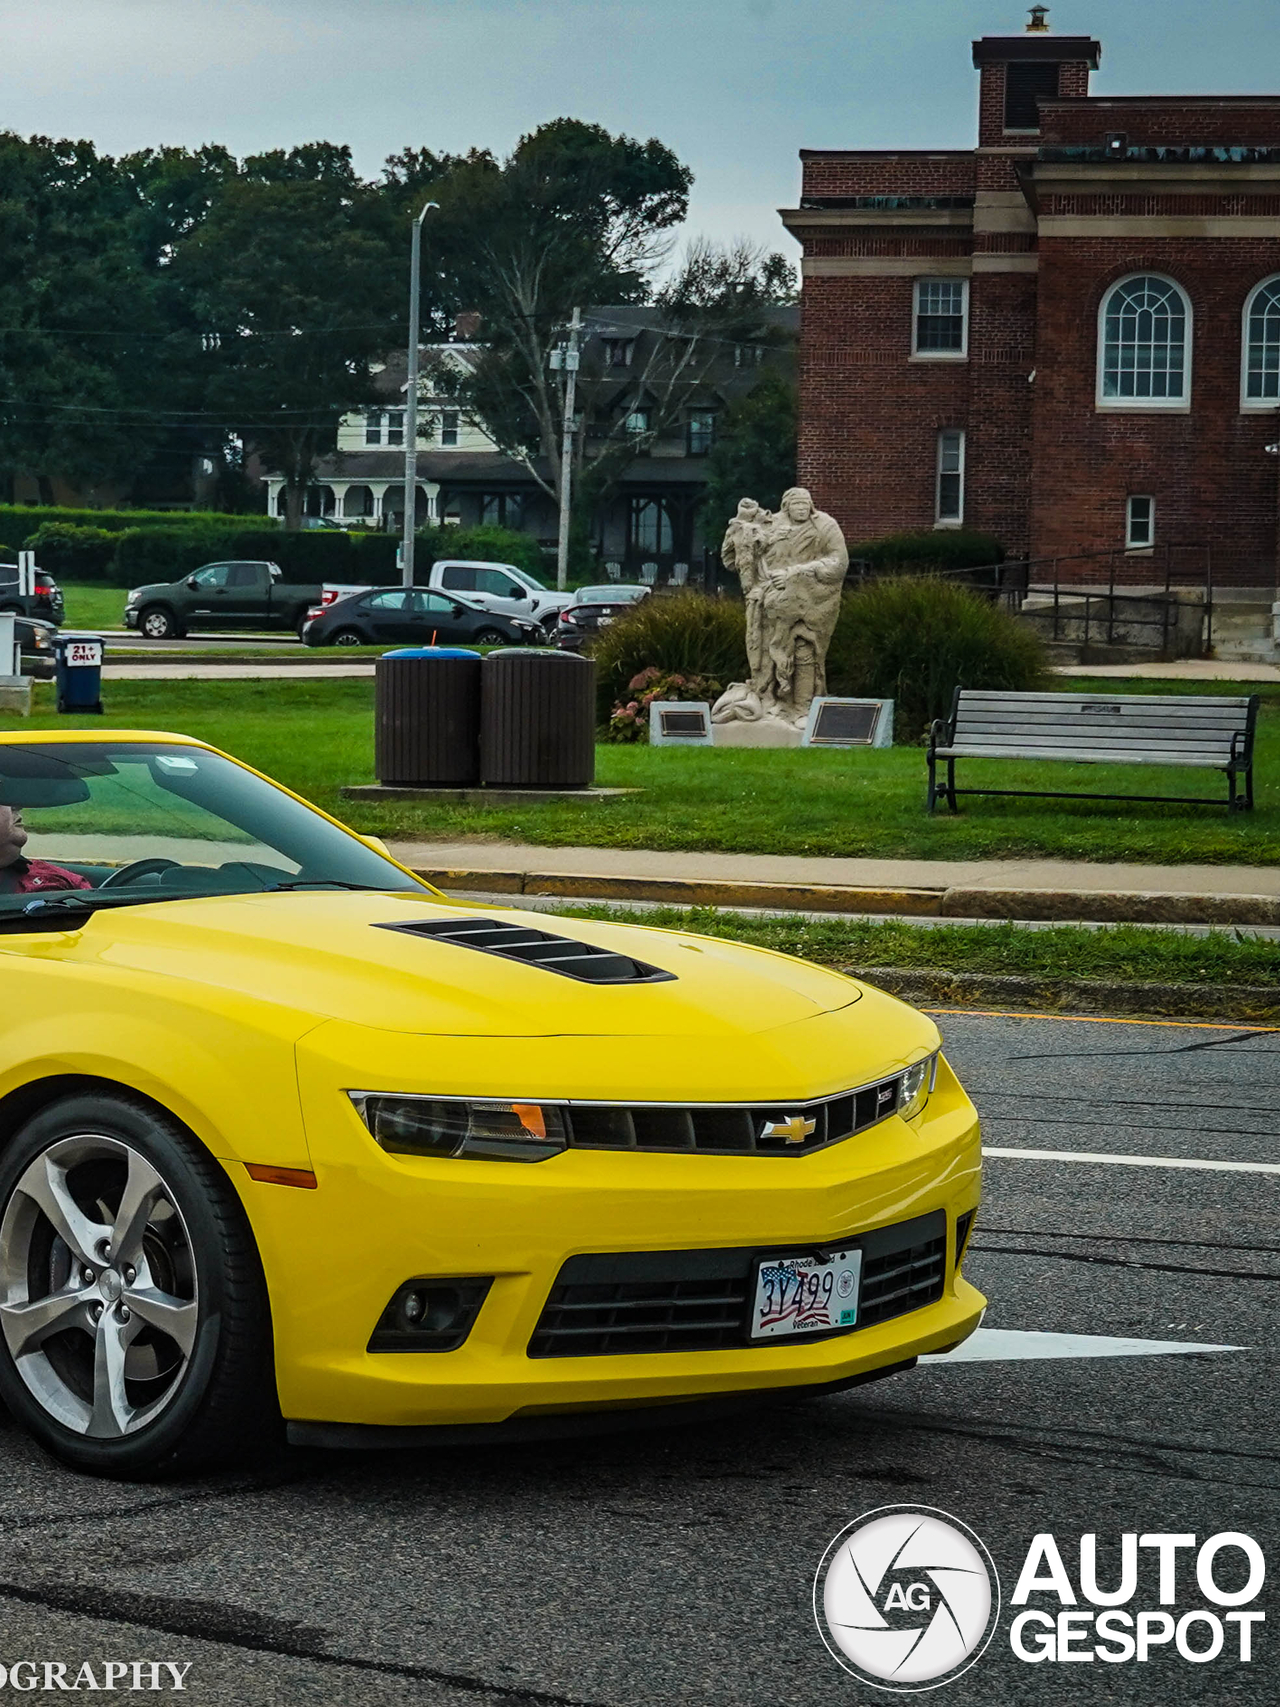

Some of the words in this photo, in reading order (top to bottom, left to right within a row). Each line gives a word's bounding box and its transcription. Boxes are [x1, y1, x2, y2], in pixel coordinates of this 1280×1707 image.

[789, 1258, 813, 1270] Rhode
[760, 1271, 833, 1317] 3Y499
[792, 1320, 819, 1329] Veteran
